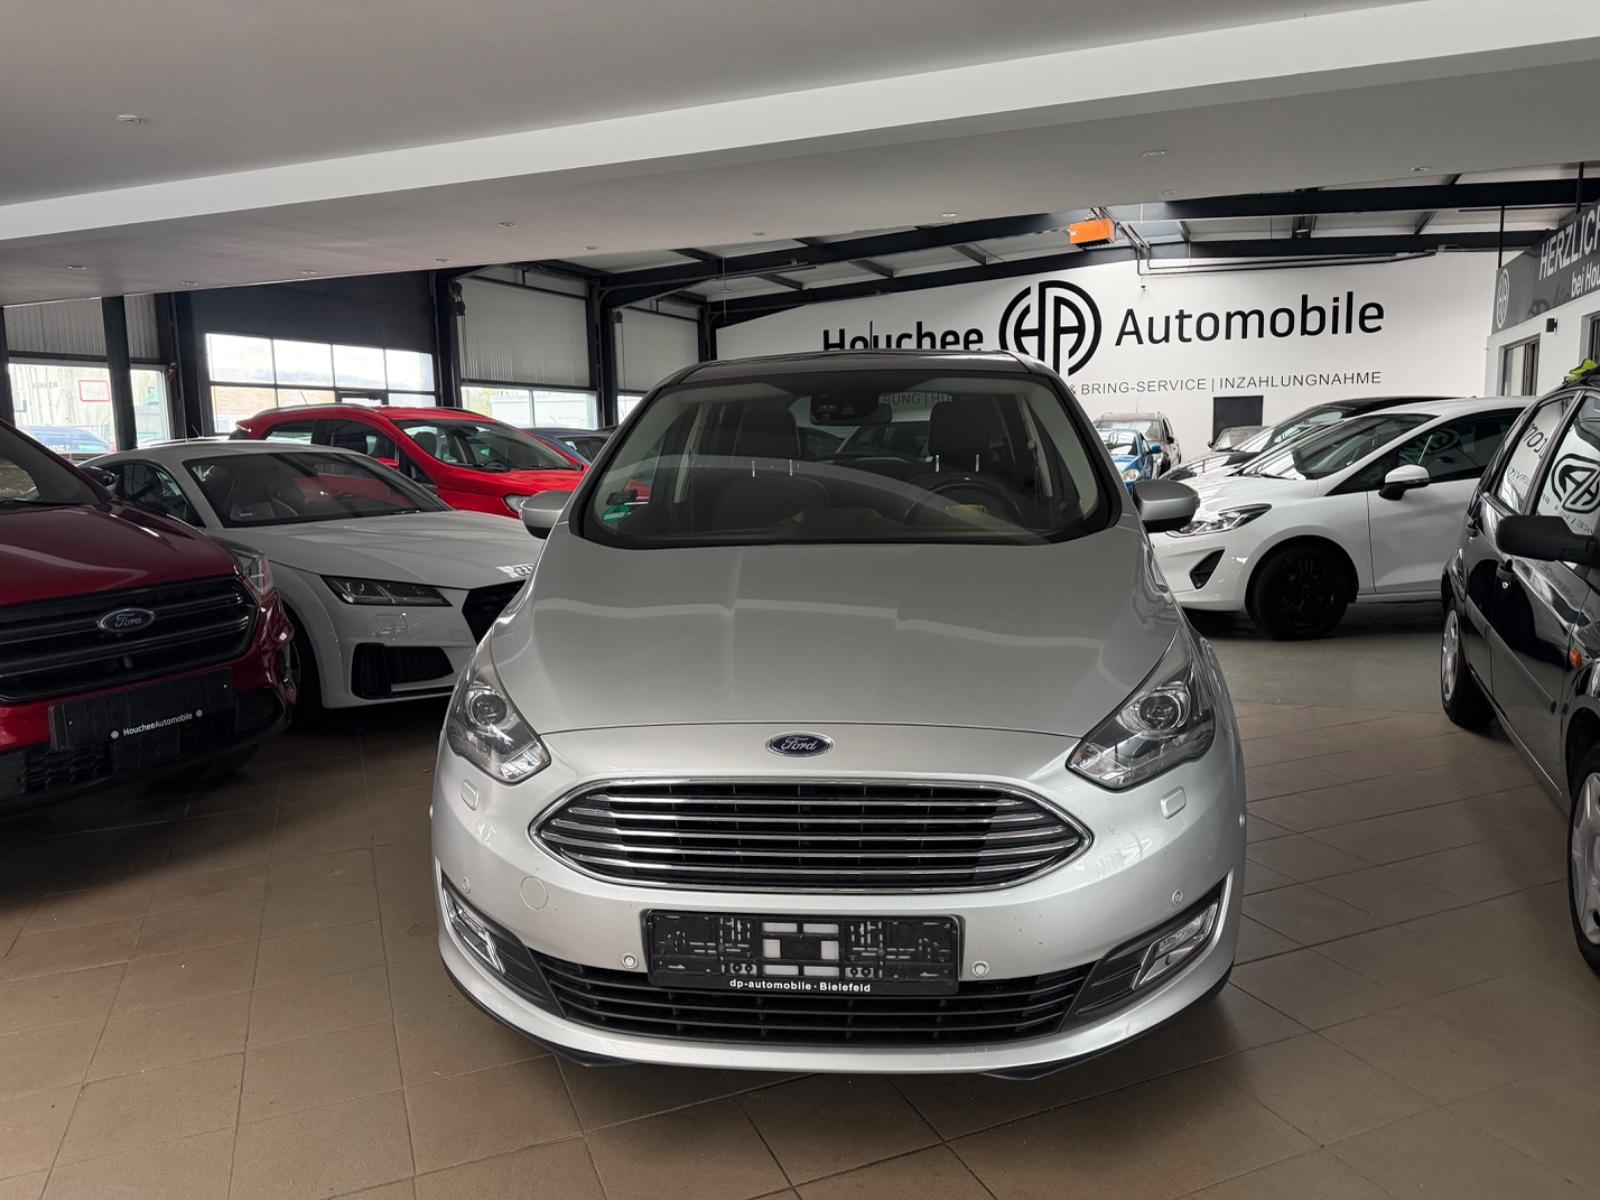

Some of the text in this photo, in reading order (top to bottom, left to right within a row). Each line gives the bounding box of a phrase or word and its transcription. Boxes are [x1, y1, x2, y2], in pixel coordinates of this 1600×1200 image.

[1571, 266, 1585, 299] bei
[823, 320, 984, 351] Houchee
[1115, 291, 1385, 346] Automobile
[1081, 378, 1207, 395] BRING-SERVICE
[1219, 371, 1382, 389] INZAHLUNGNAHME
[114, 613, 143, 628] Ford
[122, 711, 193, 737] HoucheeAutomobile
[780, 735, 818, 751] Ford
[729, 979, 871, 993] dp-automobile Bielefeld
